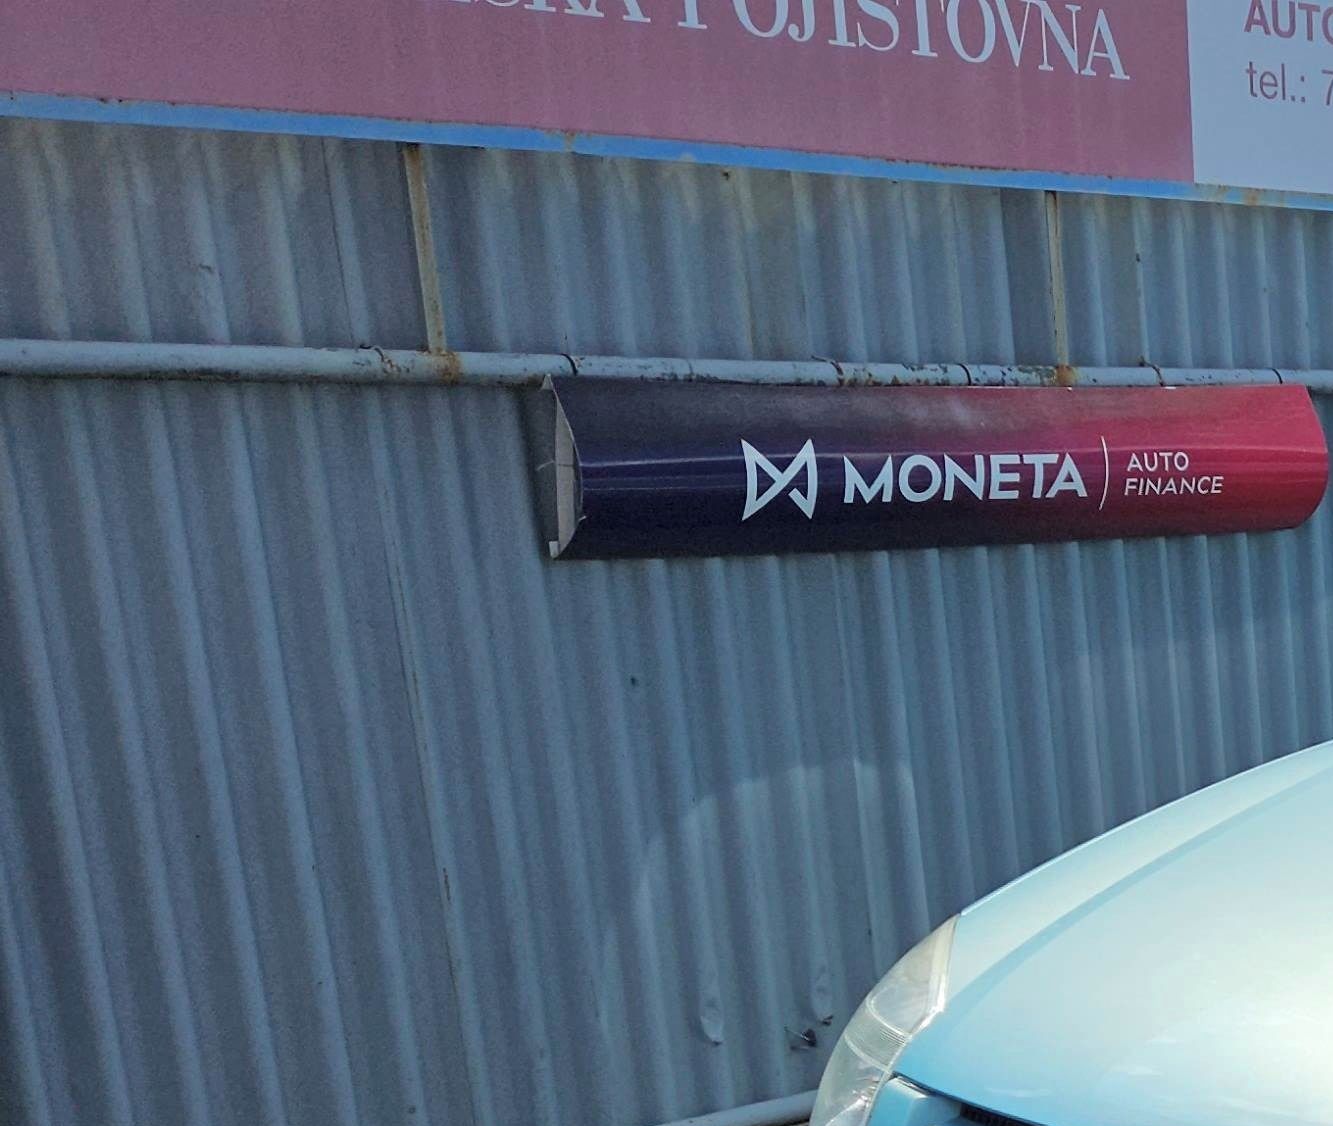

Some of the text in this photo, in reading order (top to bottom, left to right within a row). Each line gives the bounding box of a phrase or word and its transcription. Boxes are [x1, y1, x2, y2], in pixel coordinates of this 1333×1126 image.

[1246, 61, 1306, 102] tel.:
[1126, 452, 1189, 472] AUTO
[843, 453, 1088, 503] MONETA
[1124, 476, 1225, 496] FINANCE
